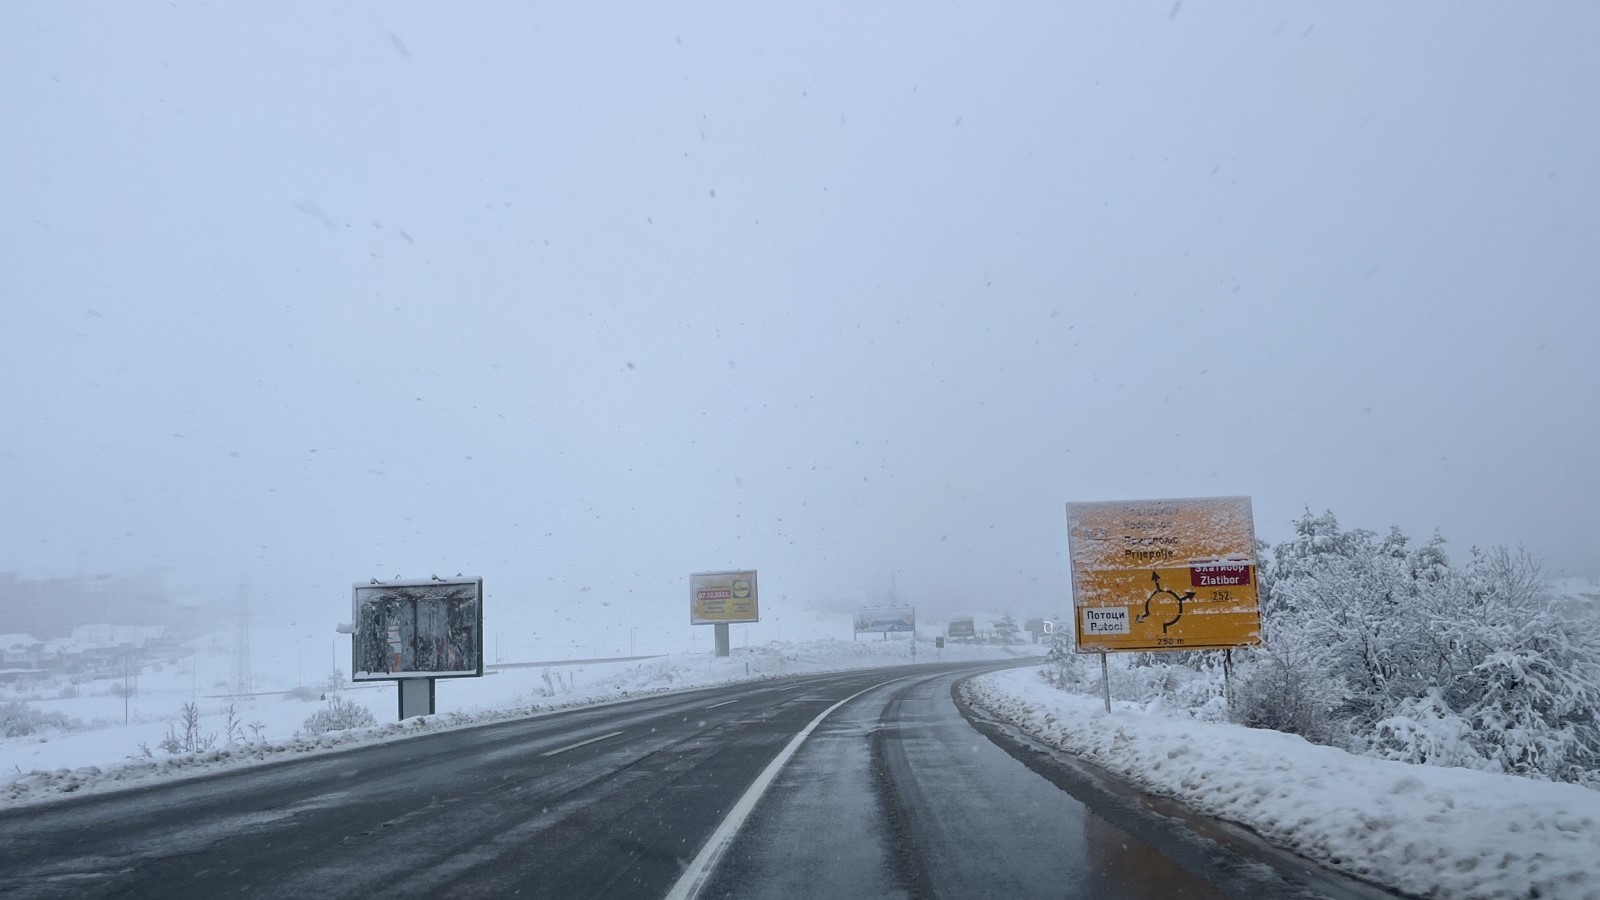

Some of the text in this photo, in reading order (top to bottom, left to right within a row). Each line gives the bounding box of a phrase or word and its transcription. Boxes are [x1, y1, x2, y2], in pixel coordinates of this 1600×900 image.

[1125, 548, 1174, 561] Prijepolje
[1200, 575, 1240, 586] Zlatibor
[1212, 591, 1230, 601] 252
[1087, 610, 1125, 620] Потоци
